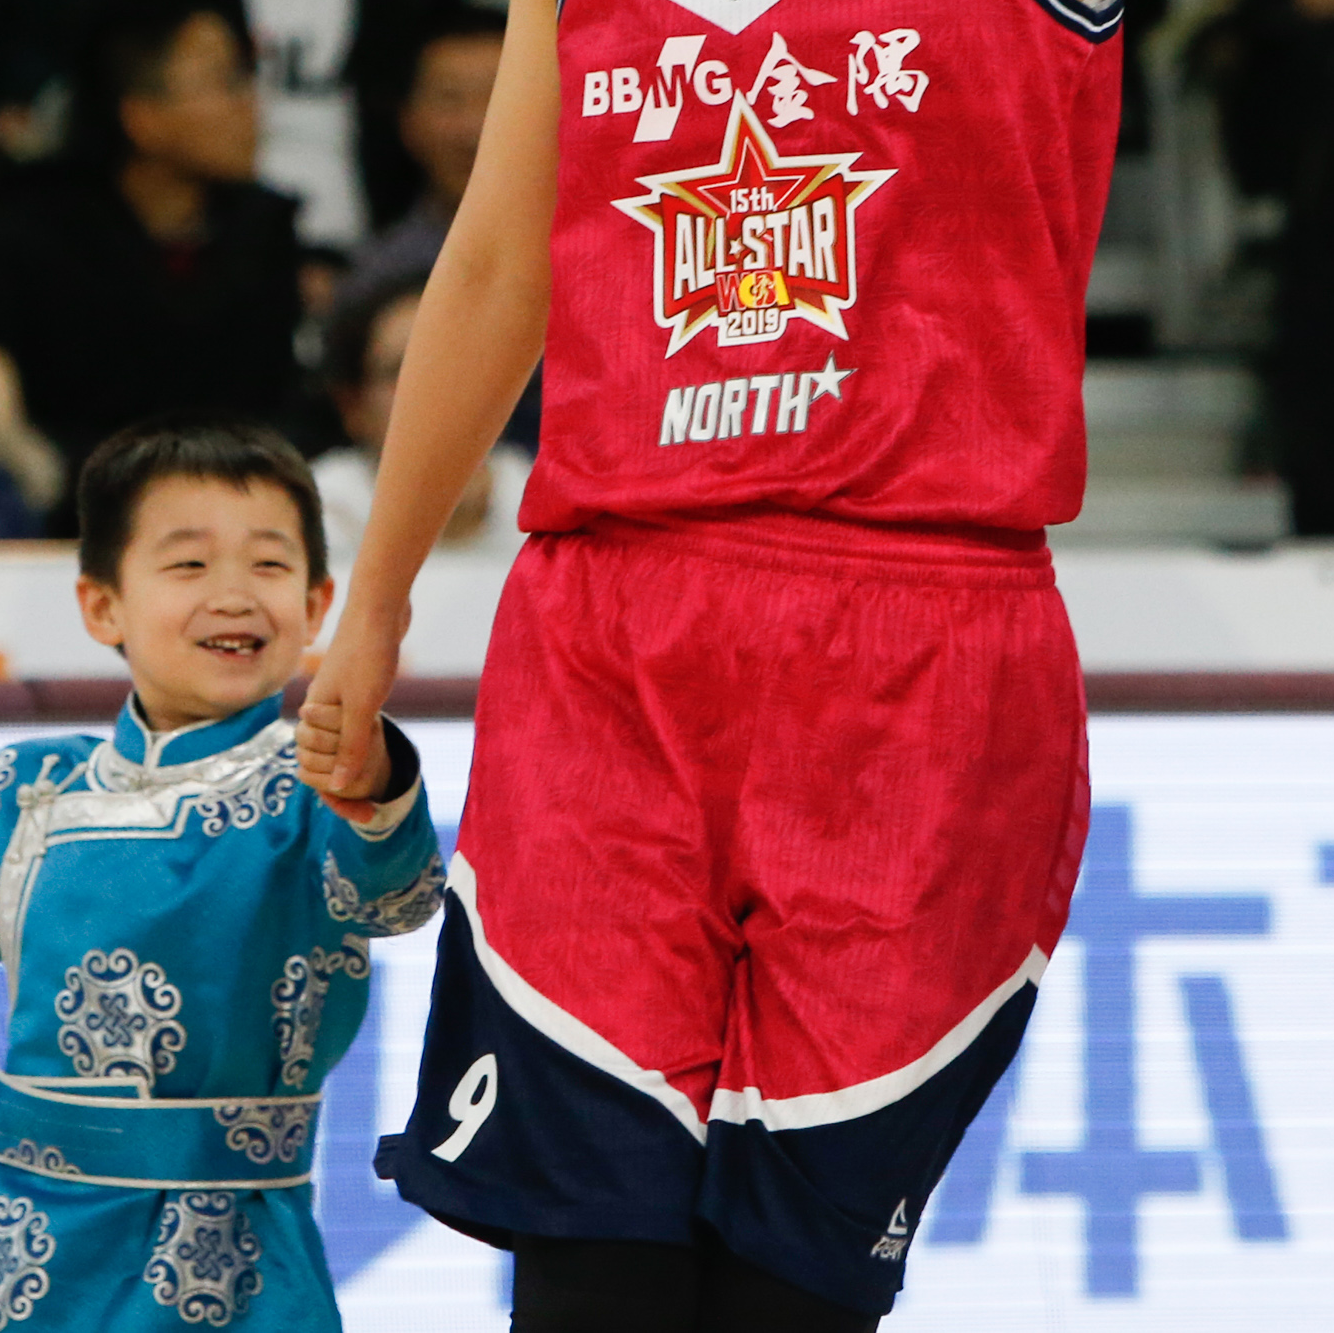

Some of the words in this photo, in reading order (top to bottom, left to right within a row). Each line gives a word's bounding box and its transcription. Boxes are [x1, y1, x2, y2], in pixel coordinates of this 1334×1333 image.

[746, 28, 930, 128] 金隅
[729, 186, 777, 214] 15th
[727, 309, 781, 338] 2019
[659, 371, 815, 446] NORTH
[431, 1053, 497, 1162] 9
